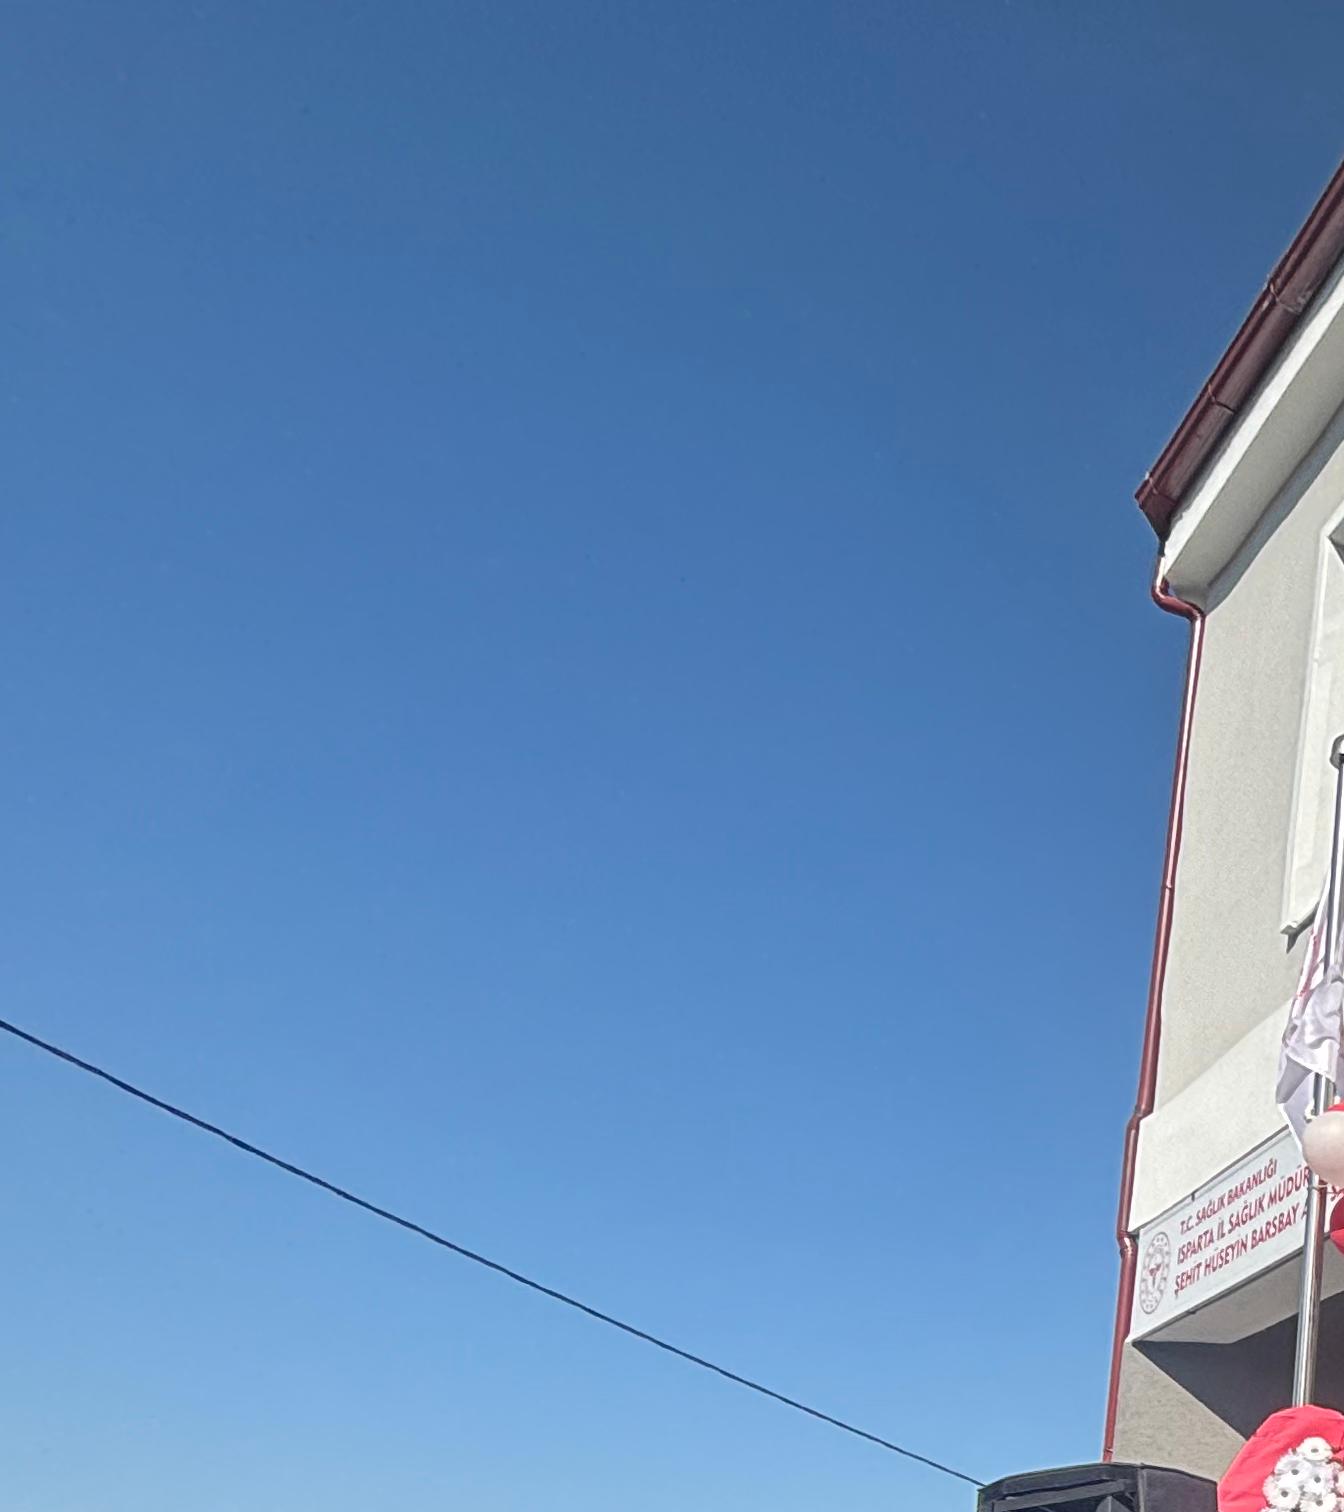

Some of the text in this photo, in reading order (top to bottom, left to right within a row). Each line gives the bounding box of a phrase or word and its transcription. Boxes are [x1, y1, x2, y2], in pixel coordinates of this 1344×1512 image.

[1177, 1229, 1214, 1265] ISPARTA
[1216, 1217, 1226, 1241] İL
[1228, 1193, 1265, 1234] SAĞLIK
[1268, 1164, 1310, 1209] MÜDÜR
[1195, 1193, 1226, 1226] SAĞLIK
[1227, 1158, 1277, 1206] BAKANLIĞI
[1174, 1260, 1202, 1300] ŞEHİT
[1204, 1233, 1248, 1277] HÜSEYİN
[1250, 1202, 1300, 1250] BARSBAY
